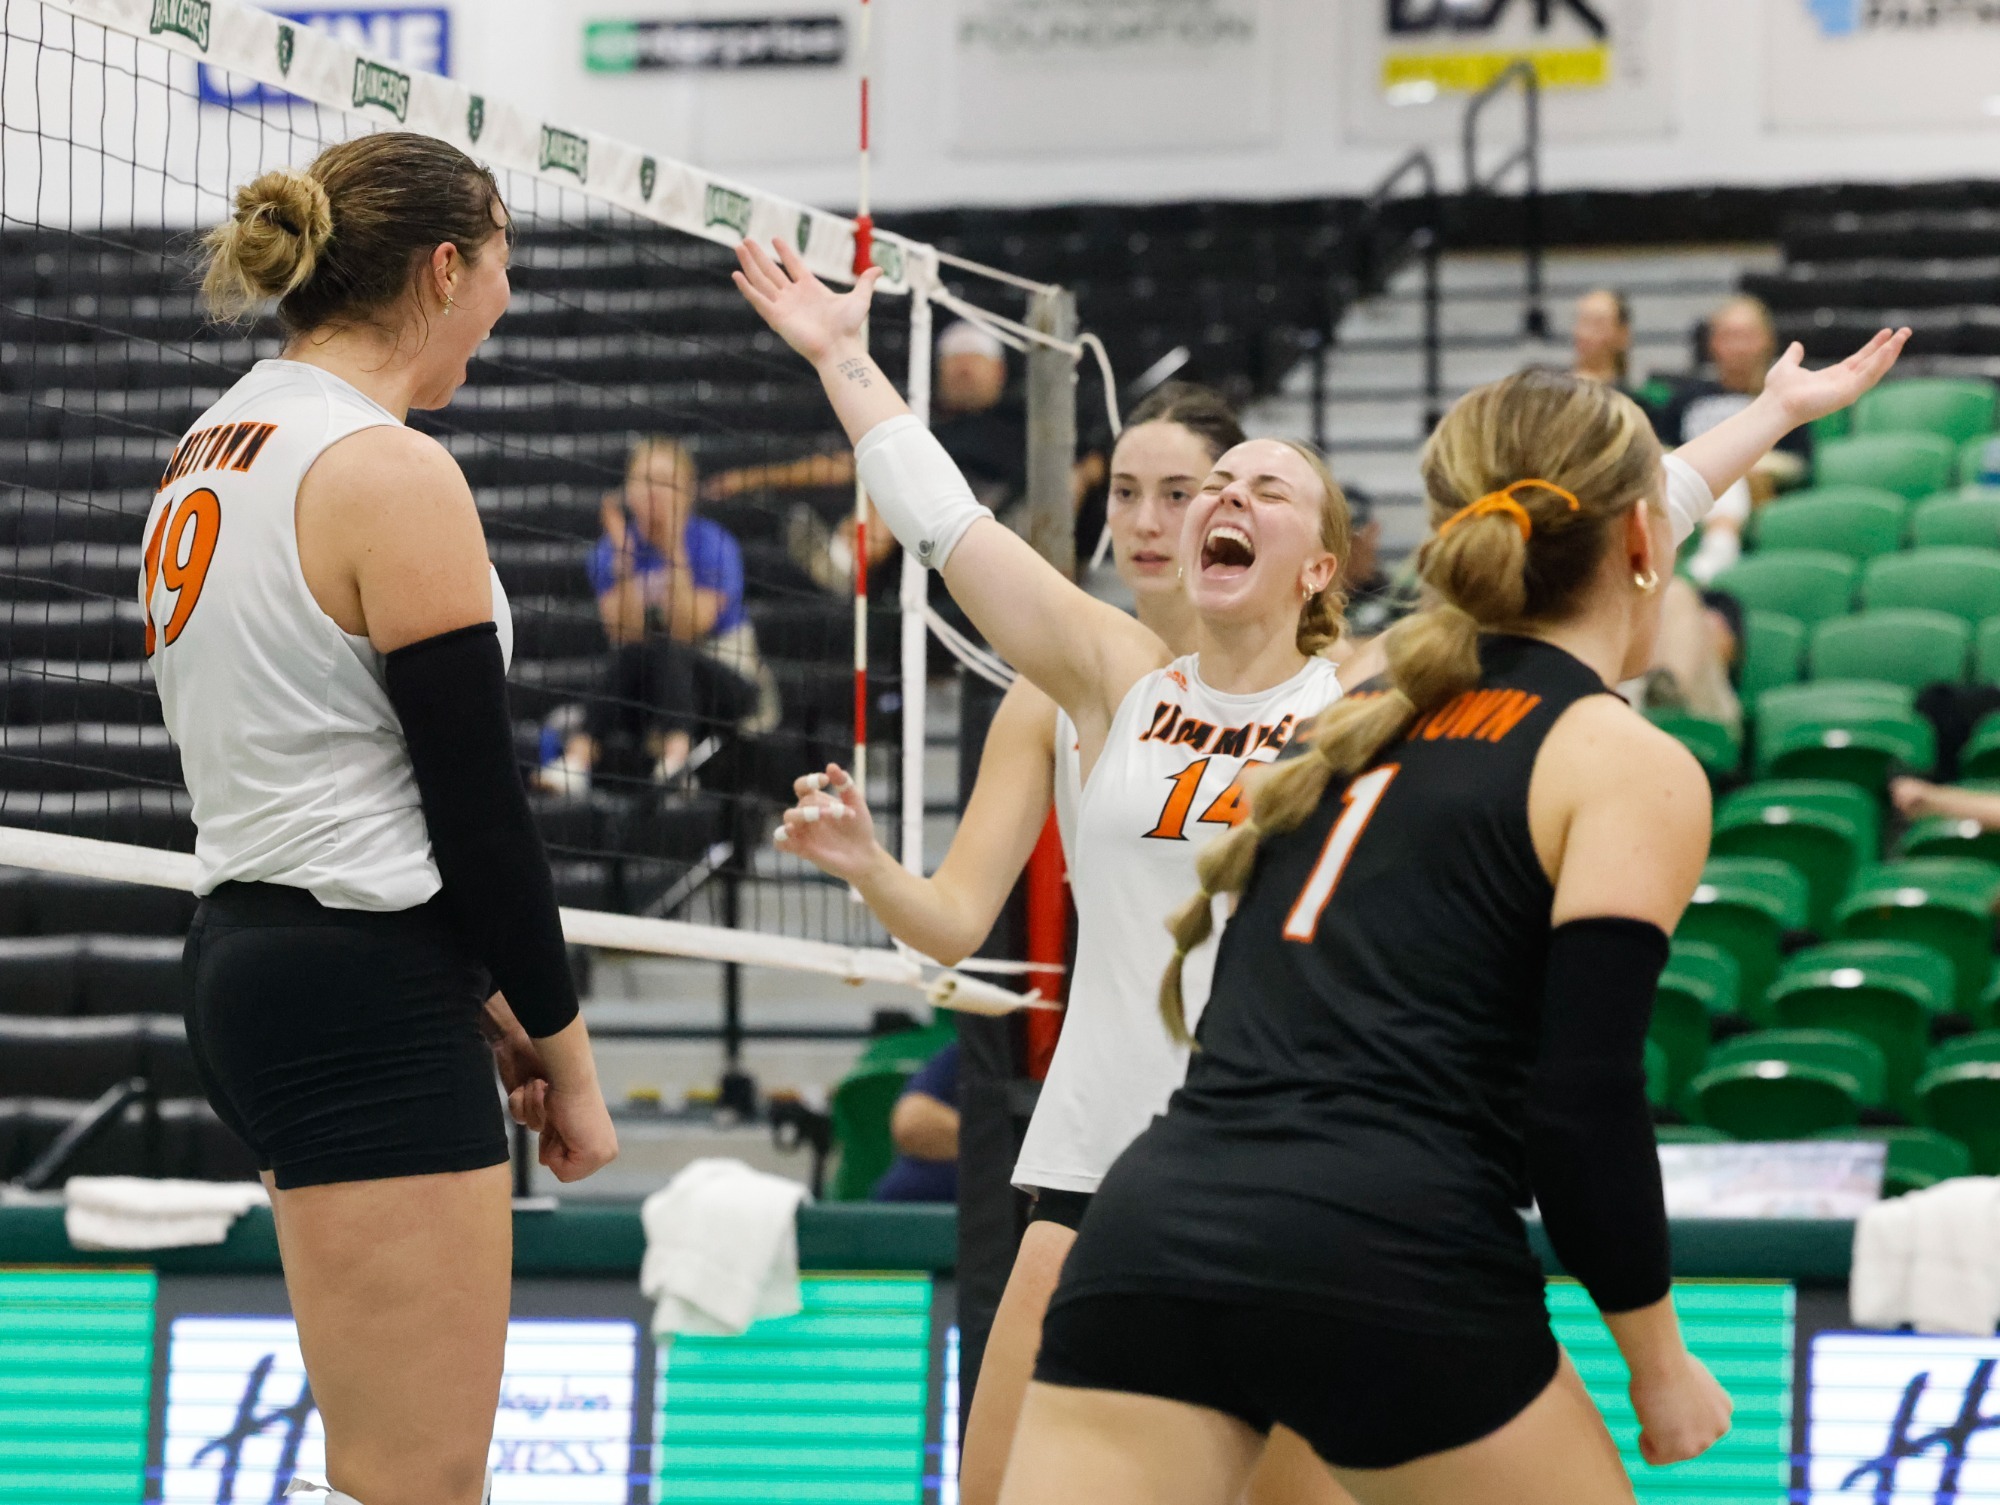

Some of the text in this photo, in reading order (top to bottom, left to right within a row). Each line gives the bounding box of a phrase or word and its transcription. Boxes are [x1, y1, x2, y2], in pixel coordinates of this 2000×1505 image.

[352, 57, 410, 123] RANGERS
[144, 488, 222, 660] 19
[1138, 700, 1296, 758] JIMMIE
[1282, 761, 1401, 943] 1
